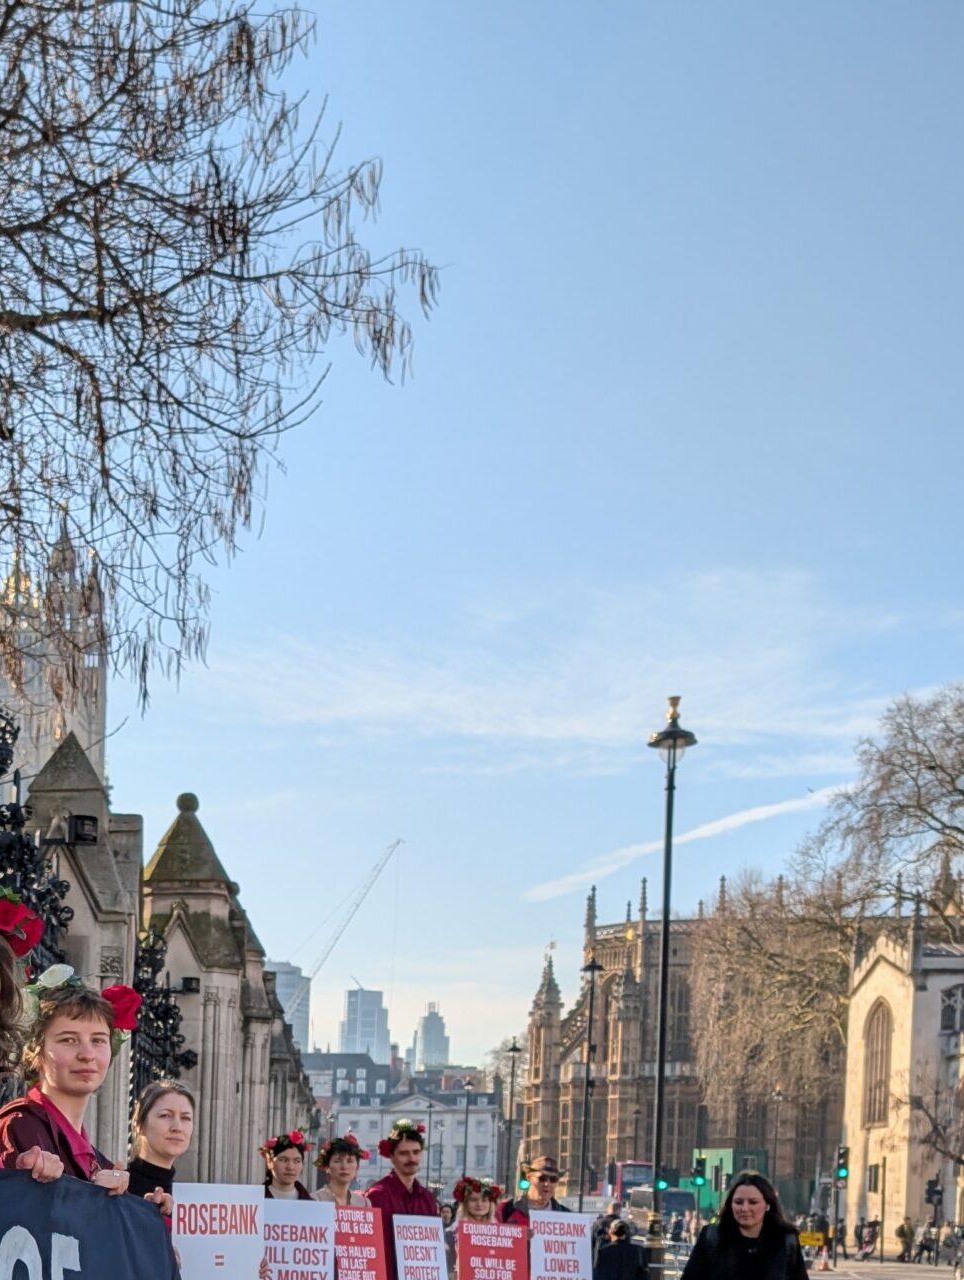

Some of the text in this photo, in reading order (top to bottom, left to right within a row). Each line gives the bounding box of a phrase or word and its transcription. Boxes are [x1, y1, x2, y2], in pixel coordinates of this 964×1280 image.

[177, 1204, 259, 1235] ROSEBANK
[339, 1210, 364, 1221] FUTURE
[366, 1211, 374, 1222] IN
[264, 1224, 328, 1244] OSEBANK
[341, 1222, 352, 1233] OIL
[354, 1223, 358, 1233] &
[360, 1224, 373, 1235] GAS
[396, 1225, 441, 1242] ROSEBANK
[463, 1223, 522, 1238] EQUINOR OWNS
[532, 1221, 586, 1237] ROSEBANK
[471, 1235, 513, 1248] ROSEBANK
[544, 1240, 576, 1255] WON'T
[293, 1248, 329, 1266] COST
[349, 1246, 376, 1258] HALVED
[403, 1245, 437, 1261] DOESN'T
[215, 1255, 224, 1266] =
[341, 1258, 367, 1270] IN LAST
[471, 1257, 516, 1270] OIL WILL BE
[544, 1258, 579, 1273] LOWER
[339, 1270, 361, 1280] ECADE
[475, 1269, 512, 1280] SOLD FOR
